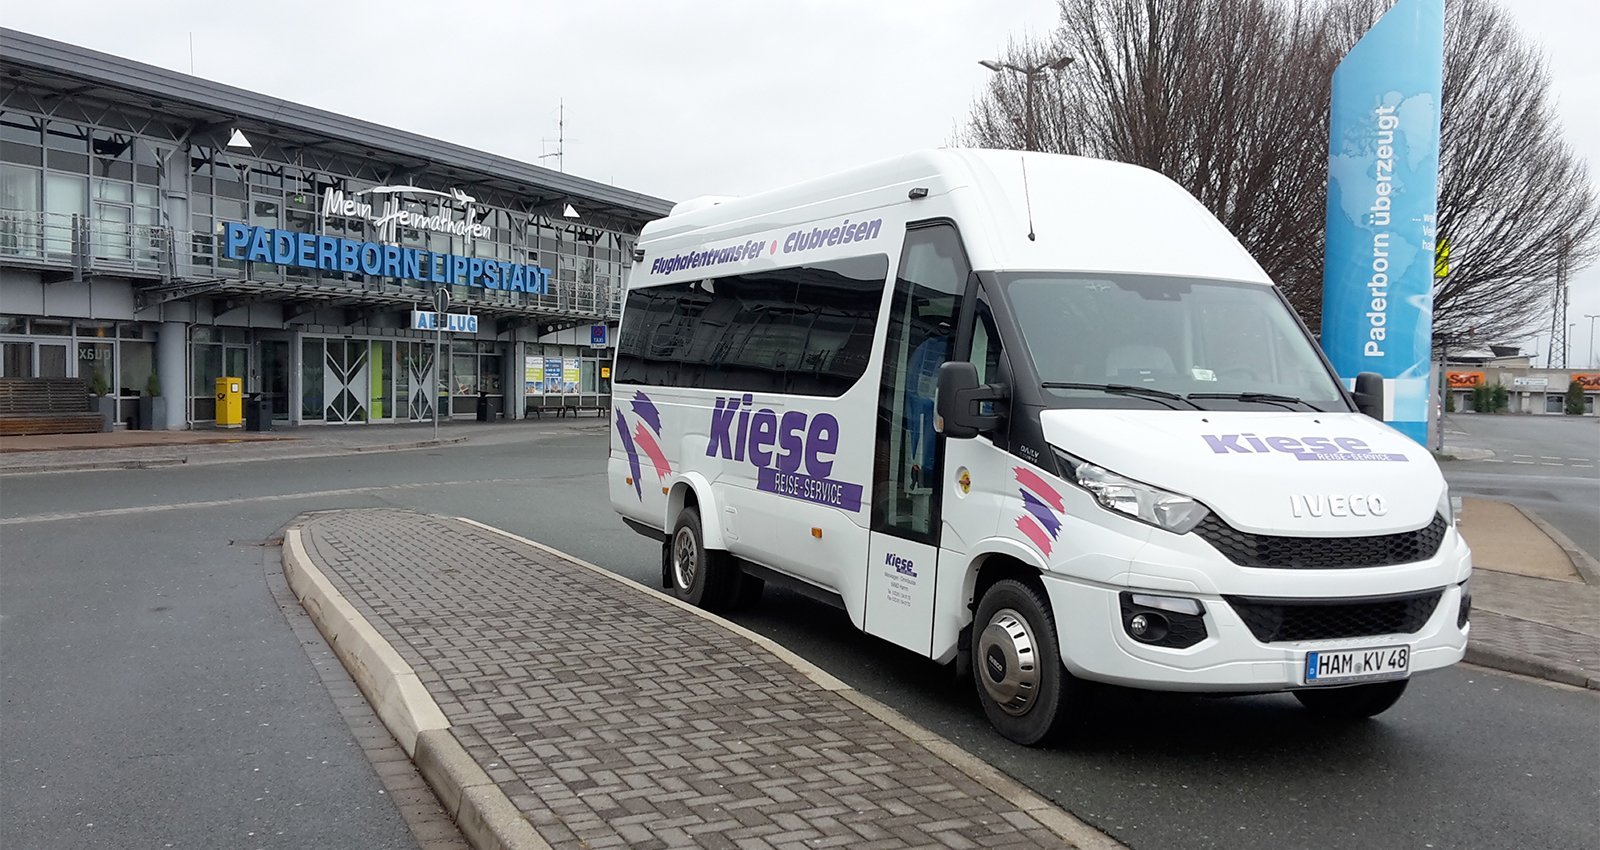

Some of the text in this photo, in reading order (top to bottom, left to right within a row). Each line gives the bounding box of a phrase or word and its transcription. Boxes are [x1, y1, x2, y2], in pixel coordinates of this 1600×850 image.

[322, 187, 491, 244] Mein Heimathafen
[1364, 105, 1399, 357] Paderborn überzeugt
[225, 222, 552, 295] PADERBORN LIPPSTADT
[650, 218, 882, 275] Flughafentransfer Clubreisen
[418, 313, 476, 331] ABLUG
[706, 393, 839, 479] Kiese
[1201, 433, 1372, 454] Kiese
[1020, 445, 1039, 458] DAILY
[1316, 453, 1391, 461] REISE-SERVICE
[1290, 494, 1388, 518] IVECO
[885, 552, 914, 572] Kiese
[1319, 649, 1407, 675] HAM KV 48
